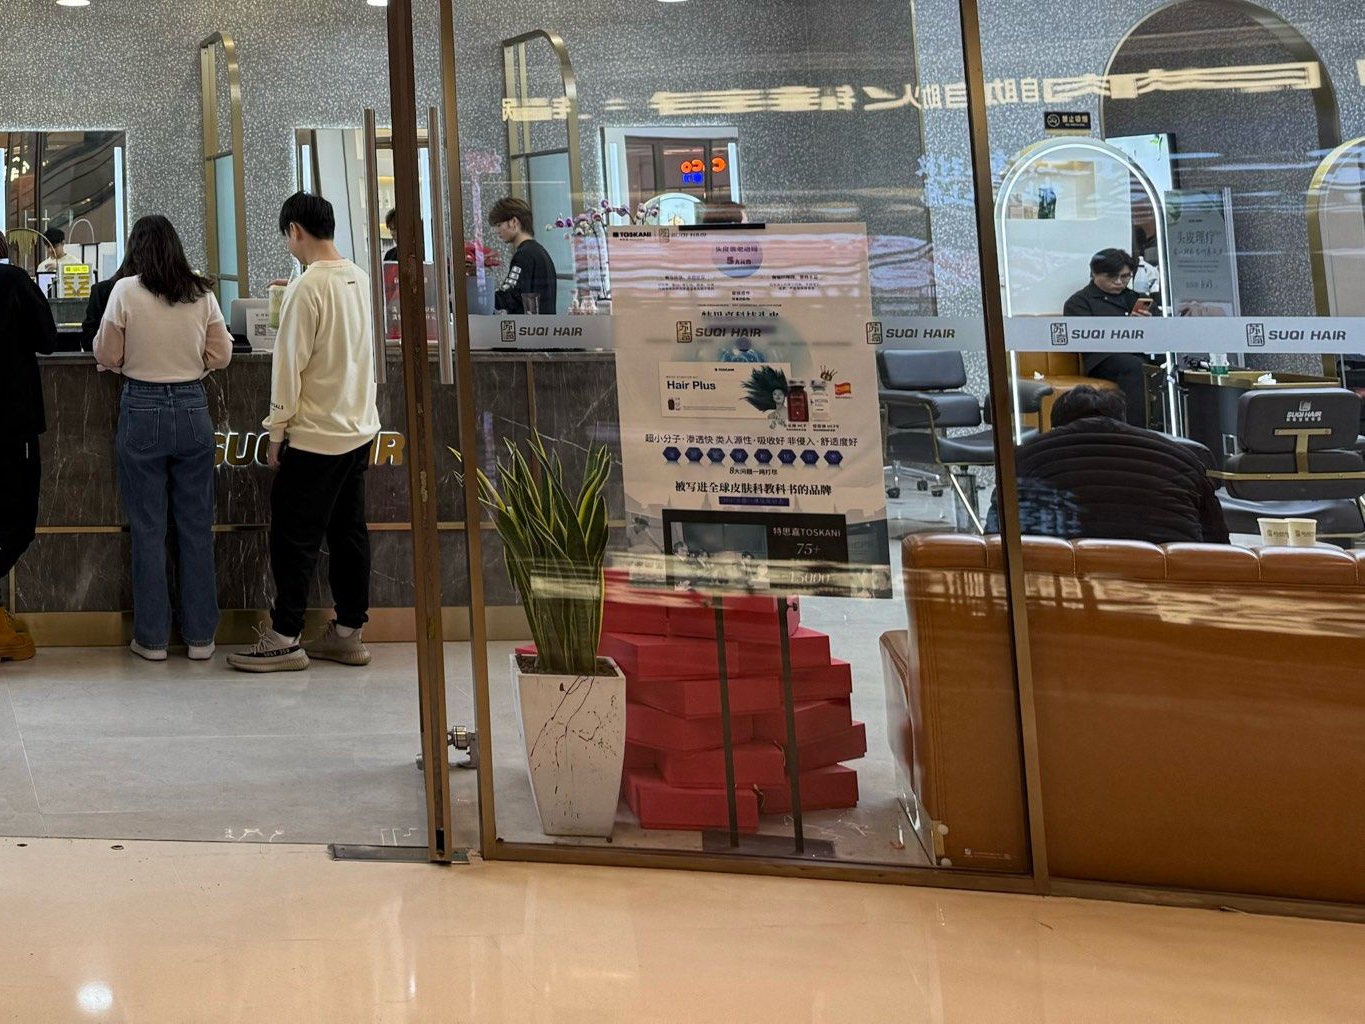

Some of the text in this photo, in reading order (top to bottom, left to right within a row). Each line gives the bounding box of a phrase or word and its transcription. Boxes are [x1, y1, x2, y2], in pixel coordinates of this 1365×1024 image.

[519, 327, 583, 337] SUQI HAIR
[695, 327, 762, 337] SUQI HAIR
[885, 328, 955, 339] SUQI HAIR
[1071, 329, 1145, 339] SUQI HAIR
[1268, 330, 1346, 340] SUQI HAIR
[667, 380, 716, 391] Hair Plus
[675, 481, 832, 496] 被写进全球皮肤科教科书的品牌
